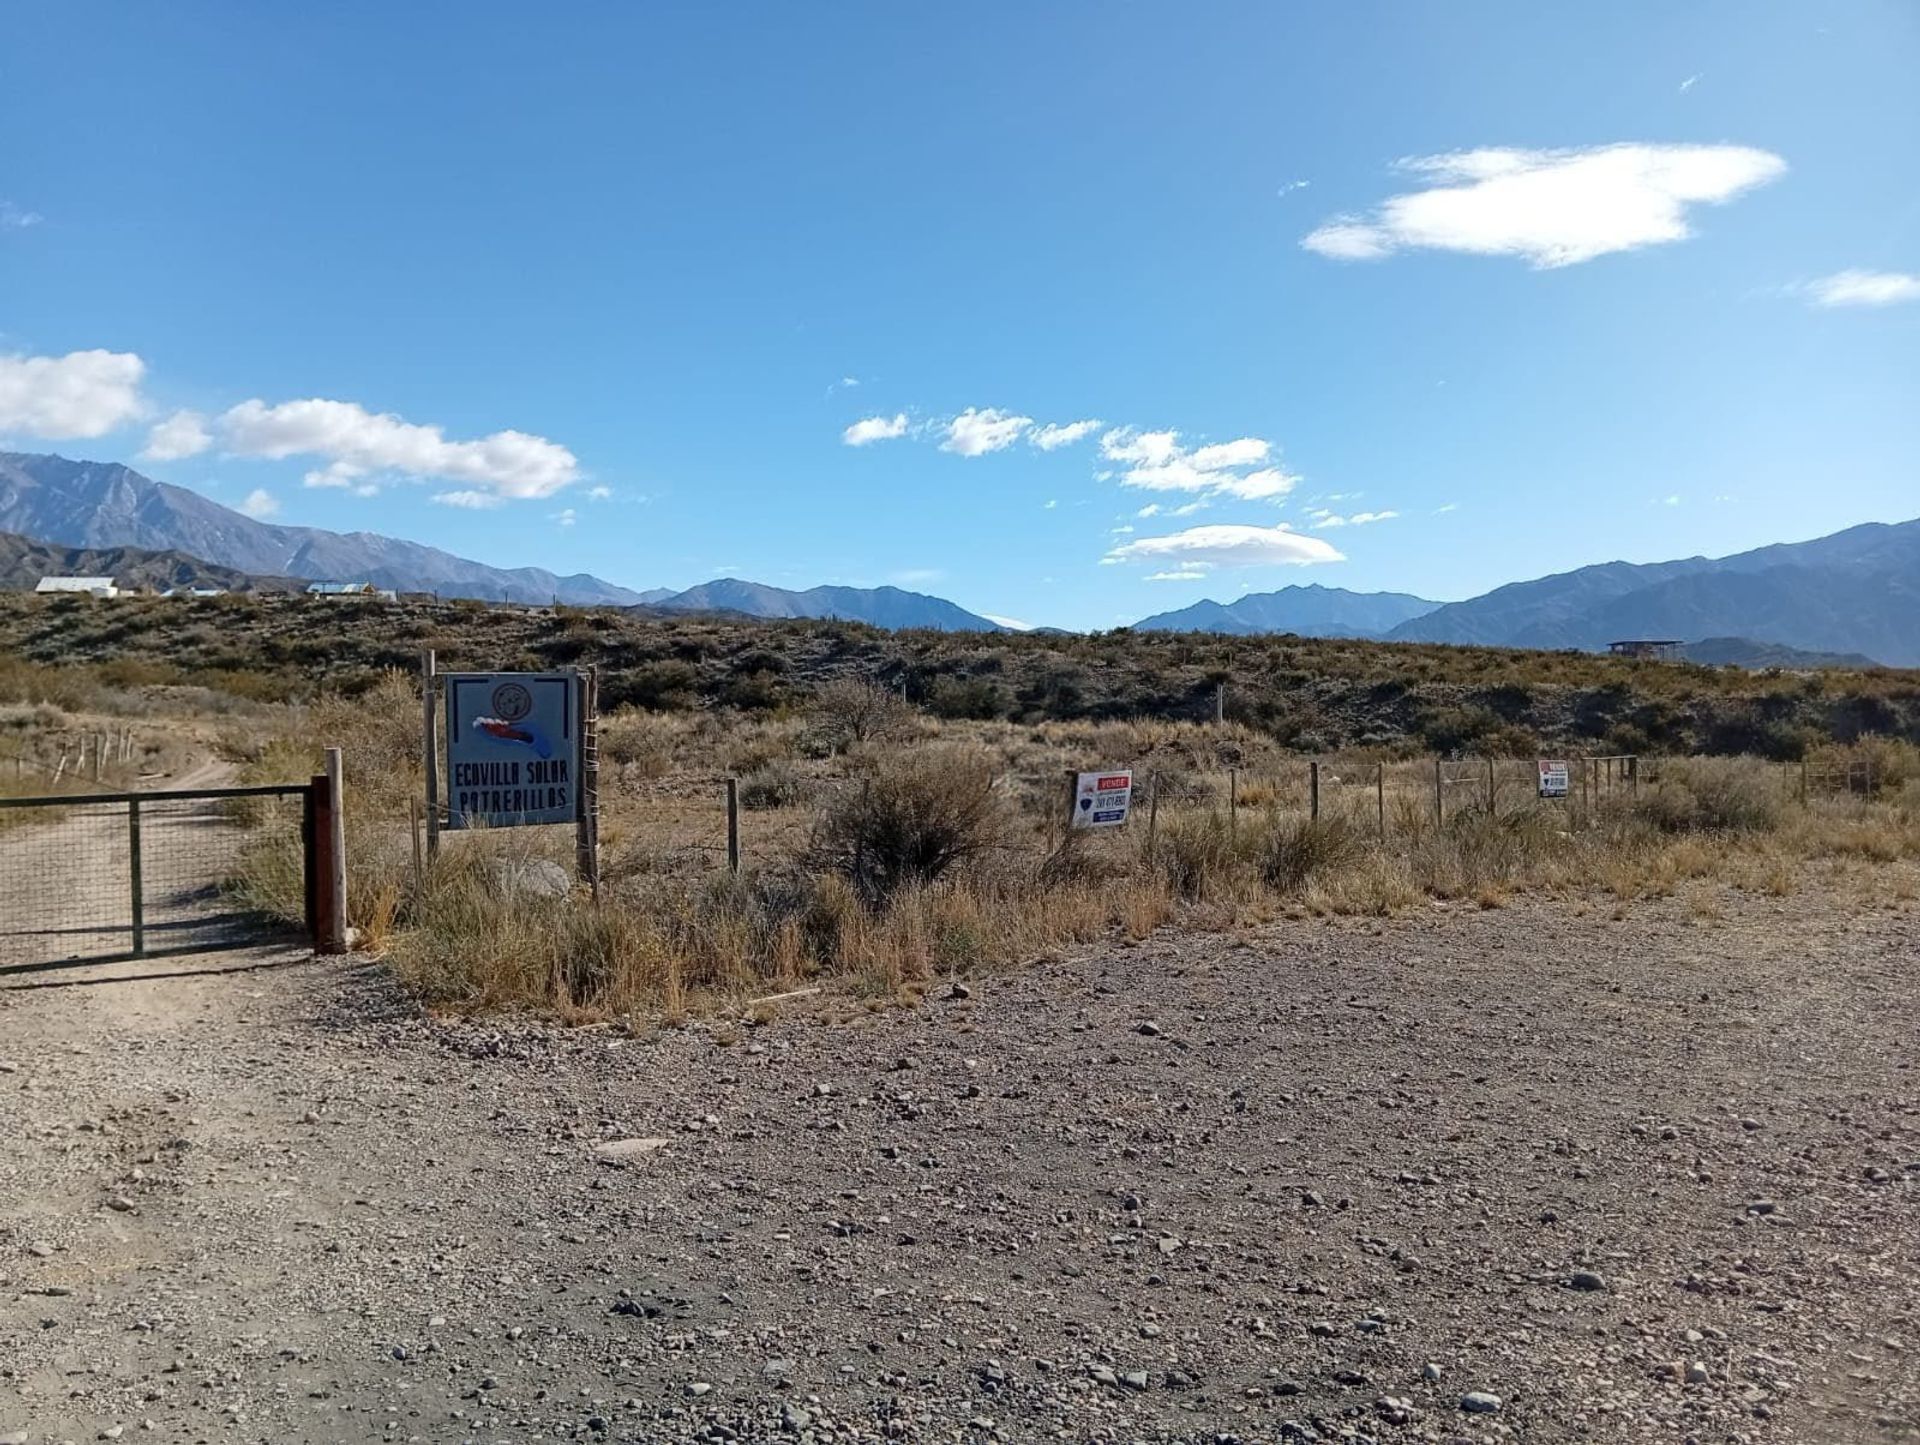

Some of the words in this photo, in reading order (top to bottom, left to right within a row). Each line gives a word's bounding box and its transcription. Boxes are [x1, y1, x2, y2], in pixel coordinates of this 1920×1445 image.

[455, 762, 520, 787] ECOVILLA
[527, 759, 569, 784] SOLAR
[460, 787, 567, 813] POTRERILLOS
